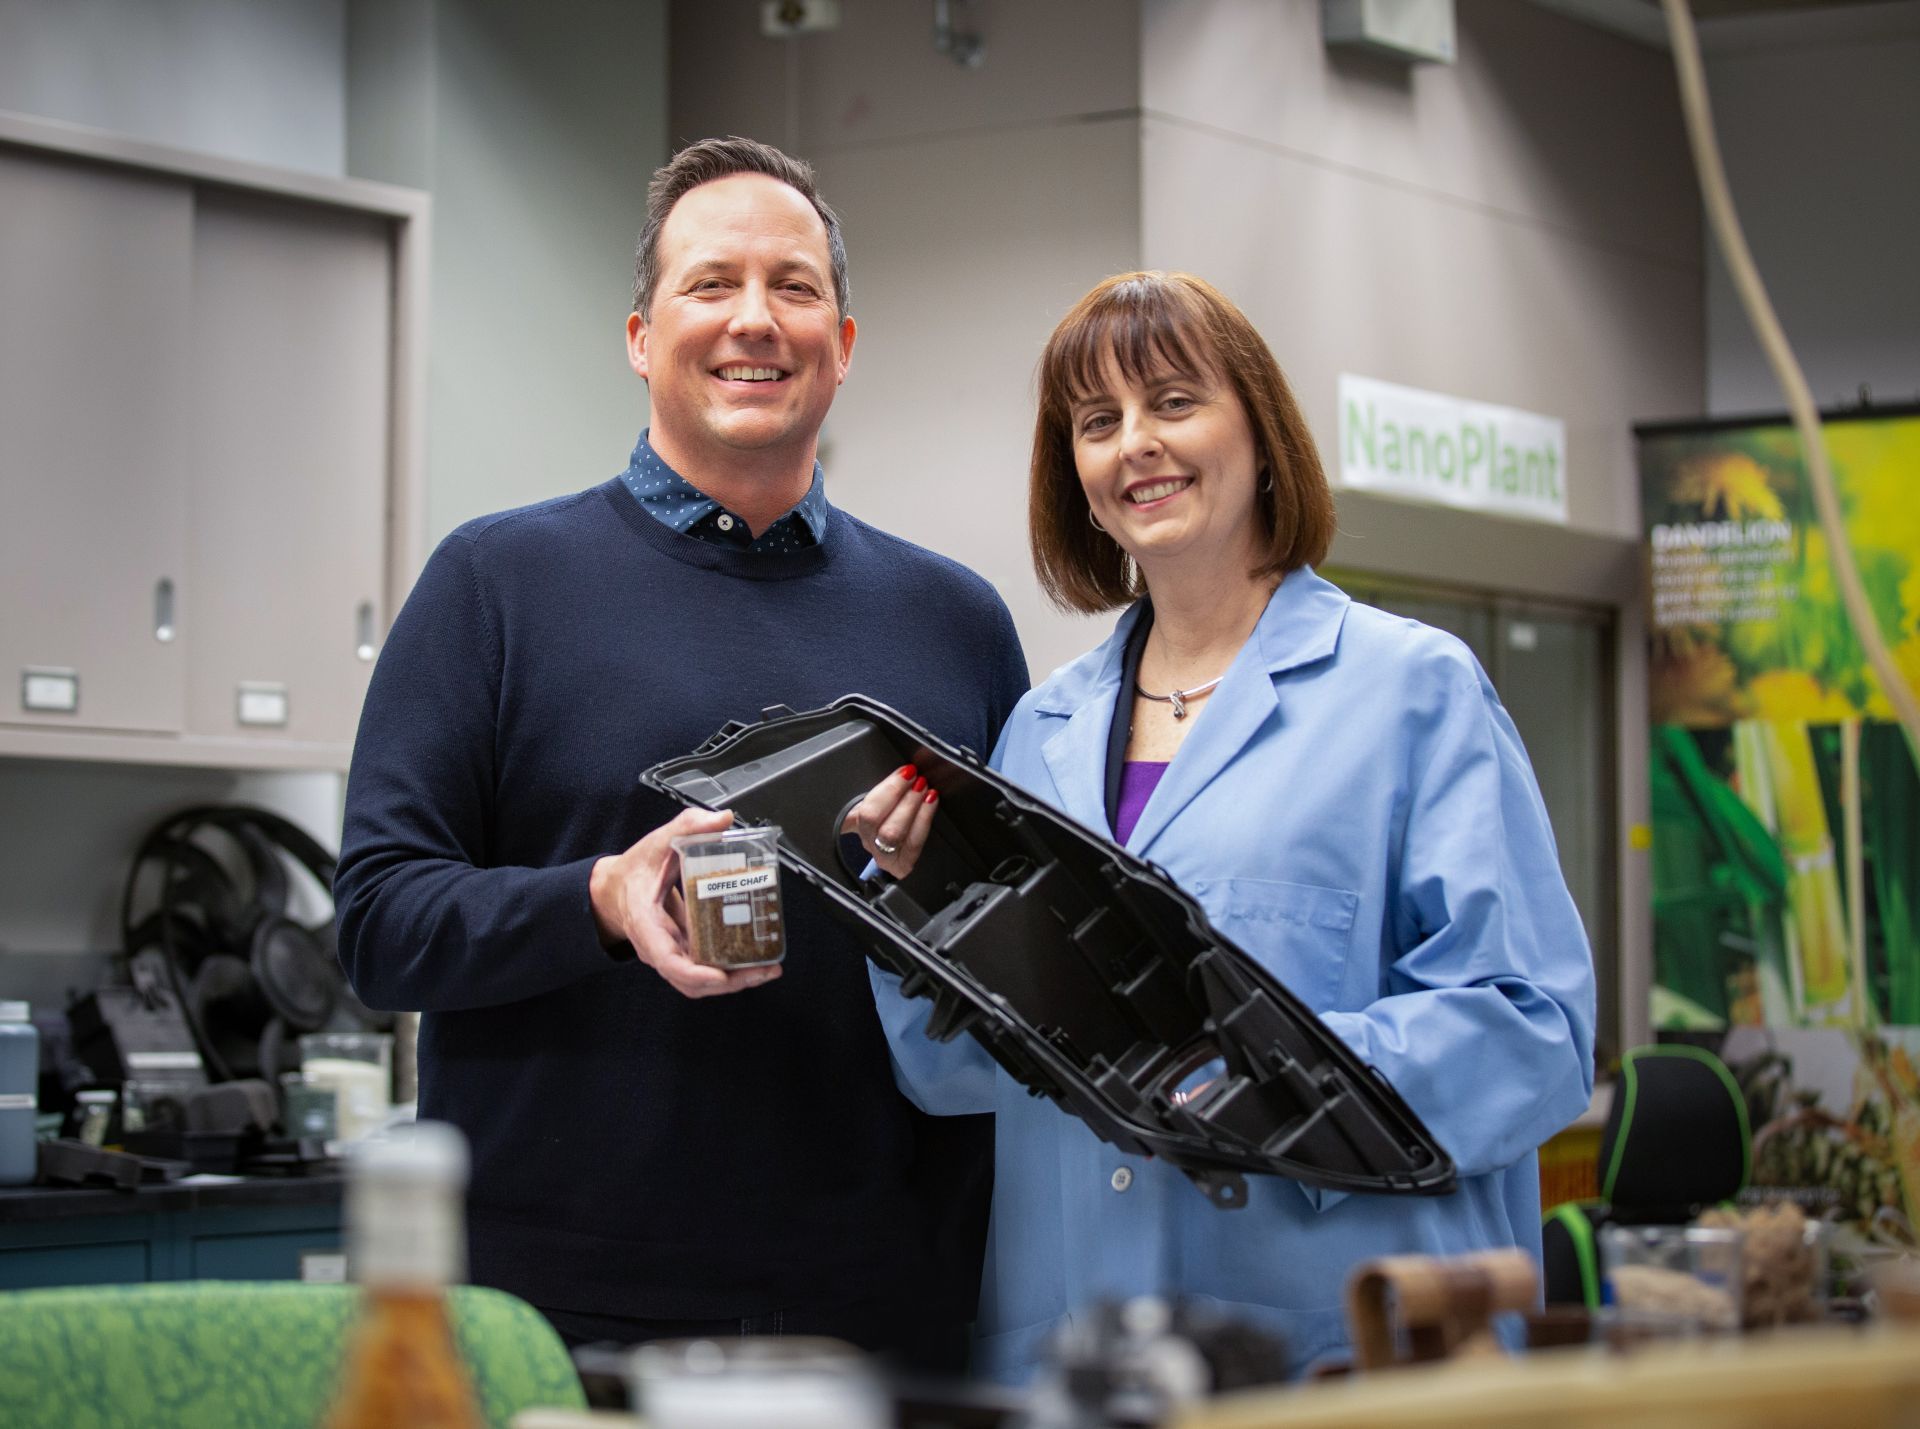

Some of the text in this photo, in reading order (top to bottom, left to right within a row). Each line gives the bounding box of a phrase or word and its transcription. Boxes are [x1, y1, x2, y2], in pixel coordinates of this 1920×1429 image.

[1345, 398, 1561, 503] NanoPlant
[1651, 519, 1792, 549] DANDELION
[707, 874, 769, 892] COFFEE CHAFF
